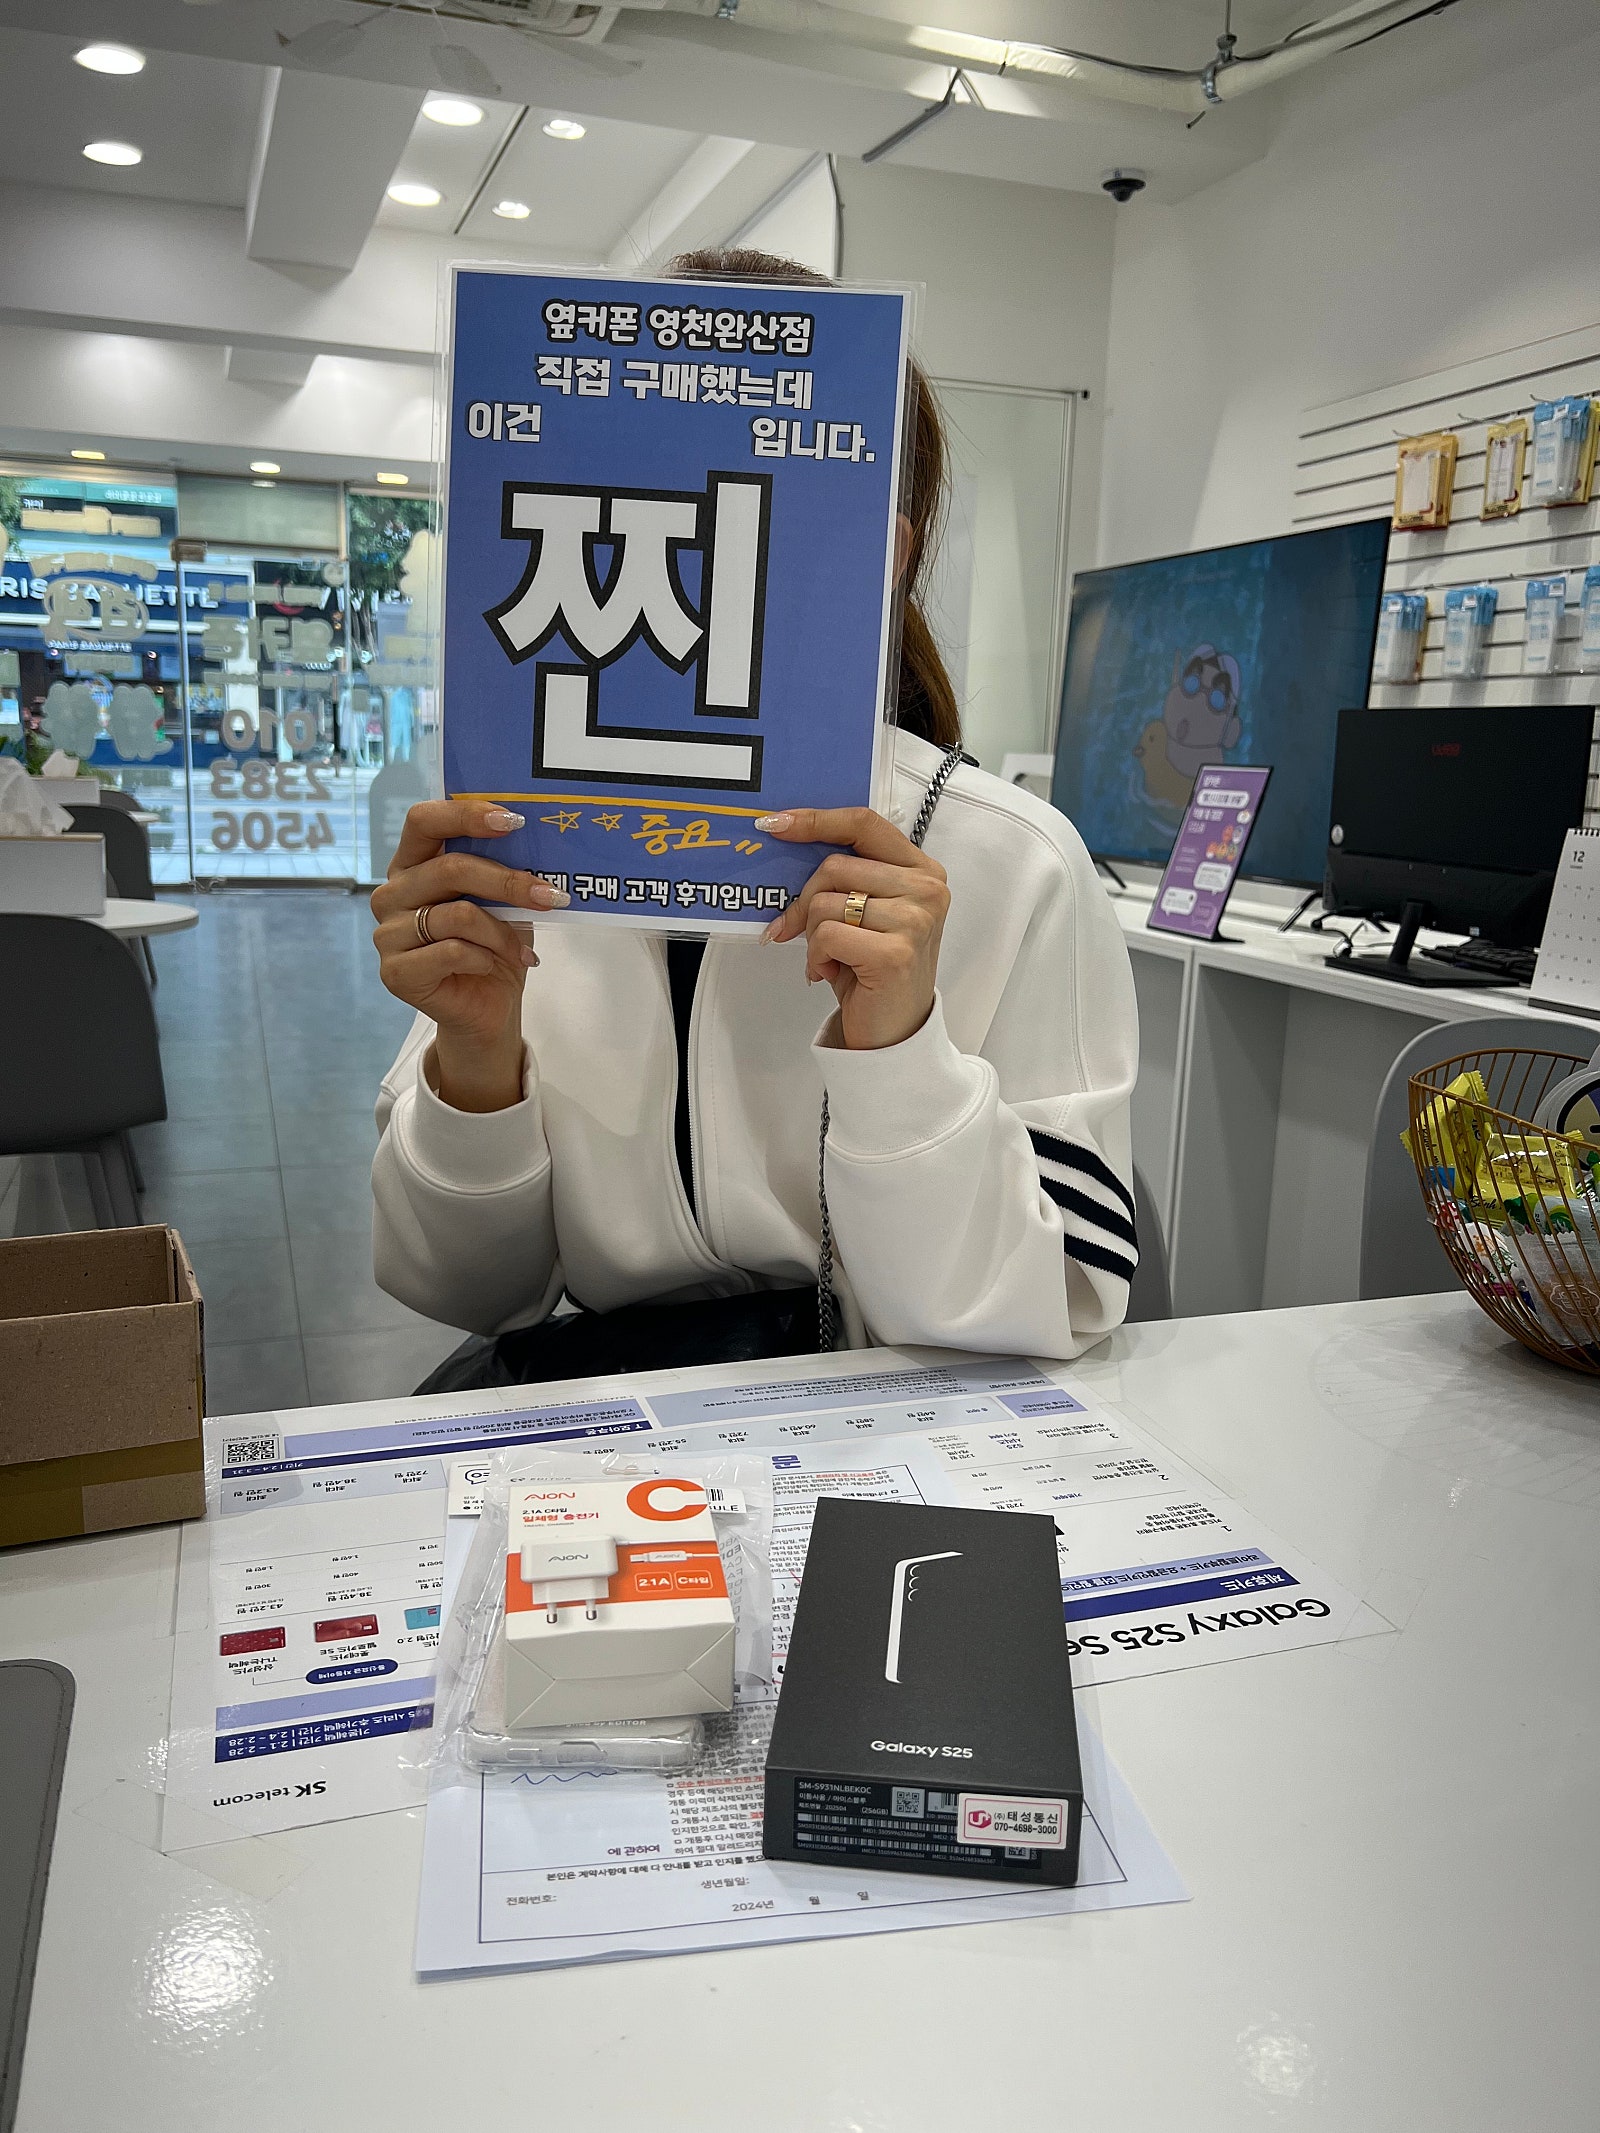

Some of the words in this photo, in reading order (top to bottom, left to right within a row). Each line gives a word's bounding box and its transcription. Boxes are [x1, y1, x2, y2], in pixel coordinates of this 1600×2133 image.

[543, 300, 641, 345] 옆커폰
[646, 306, 813, 355] 영천완산점
[536, 355, 611, 397] 직접
[622, 359, 814, 410] 구매했는데
[466, 401, 543, 443] 이건
[751, 416, 876, 463] 입니다.
[488, 474, 770, 787] 찐
[1573, 850, 1585, 864] 12
[526, 871, 569, 894] 제
[574, 874, 619, 901] 구매
[624, 879, 669, 907] 고객
[626, 1478, 709, 1522] C
[638, 1577, 671, 1587] 2.1A
[677, 1575, 710, 1585] C타입
[1220, 1571, 1287, 1592] 제휴카드
[1186, 1598, 1331, 1636] Galaxy
[1110, 1622, 1186, 1651] S25
[371, 1711, 405, 1724] 시리즈
[269, 1730, 288, 1741] 2.4
[297, 1726, 321, 1738] 기간
[323, 1728, 370, 1743] 기본혜택
[228, 1736, 256, 1747] 2.28
[269, 1739, 288, 1750] 2.1
[297, 1735, 321, 1747] 기간
[228, 1745, 256, 1757] 2.28
[870, 1740, 939, 1758] Galaxy
[941, 1746, 974, 1759] S25
[293, 1779, 327, 1798] SK
[212, 1786, 290, 1808] telecom
[1007, 1810, 1059, 1824] 태성통신
[993, 1822, 1058, 1836] 070-4698-3000
[608, 1846, 622, 1857] 에
[625, 1842, 661, 1857] 관하여
[547, 1870, 576, 1882] 본인은
[579, 1866, 629, 1880] 계약사항에
[630, 1864, 649, 1875] 대해
[652, 1863, 661, 1873] 다
[663, 1859, 692, 1872] 안내를
[694, 1857, 714, 1869] 받고
[716, 1855, 744, 1867] 인지를
[701, 1875, 751, 1890] 생년월일:
[506, 1892, 558, 1907] 전화번호:
[733, 1898, 776, 1913] 2024년
[810, 1894, 822, 1907] 월
[857, 1889, 871, 1902] 일
